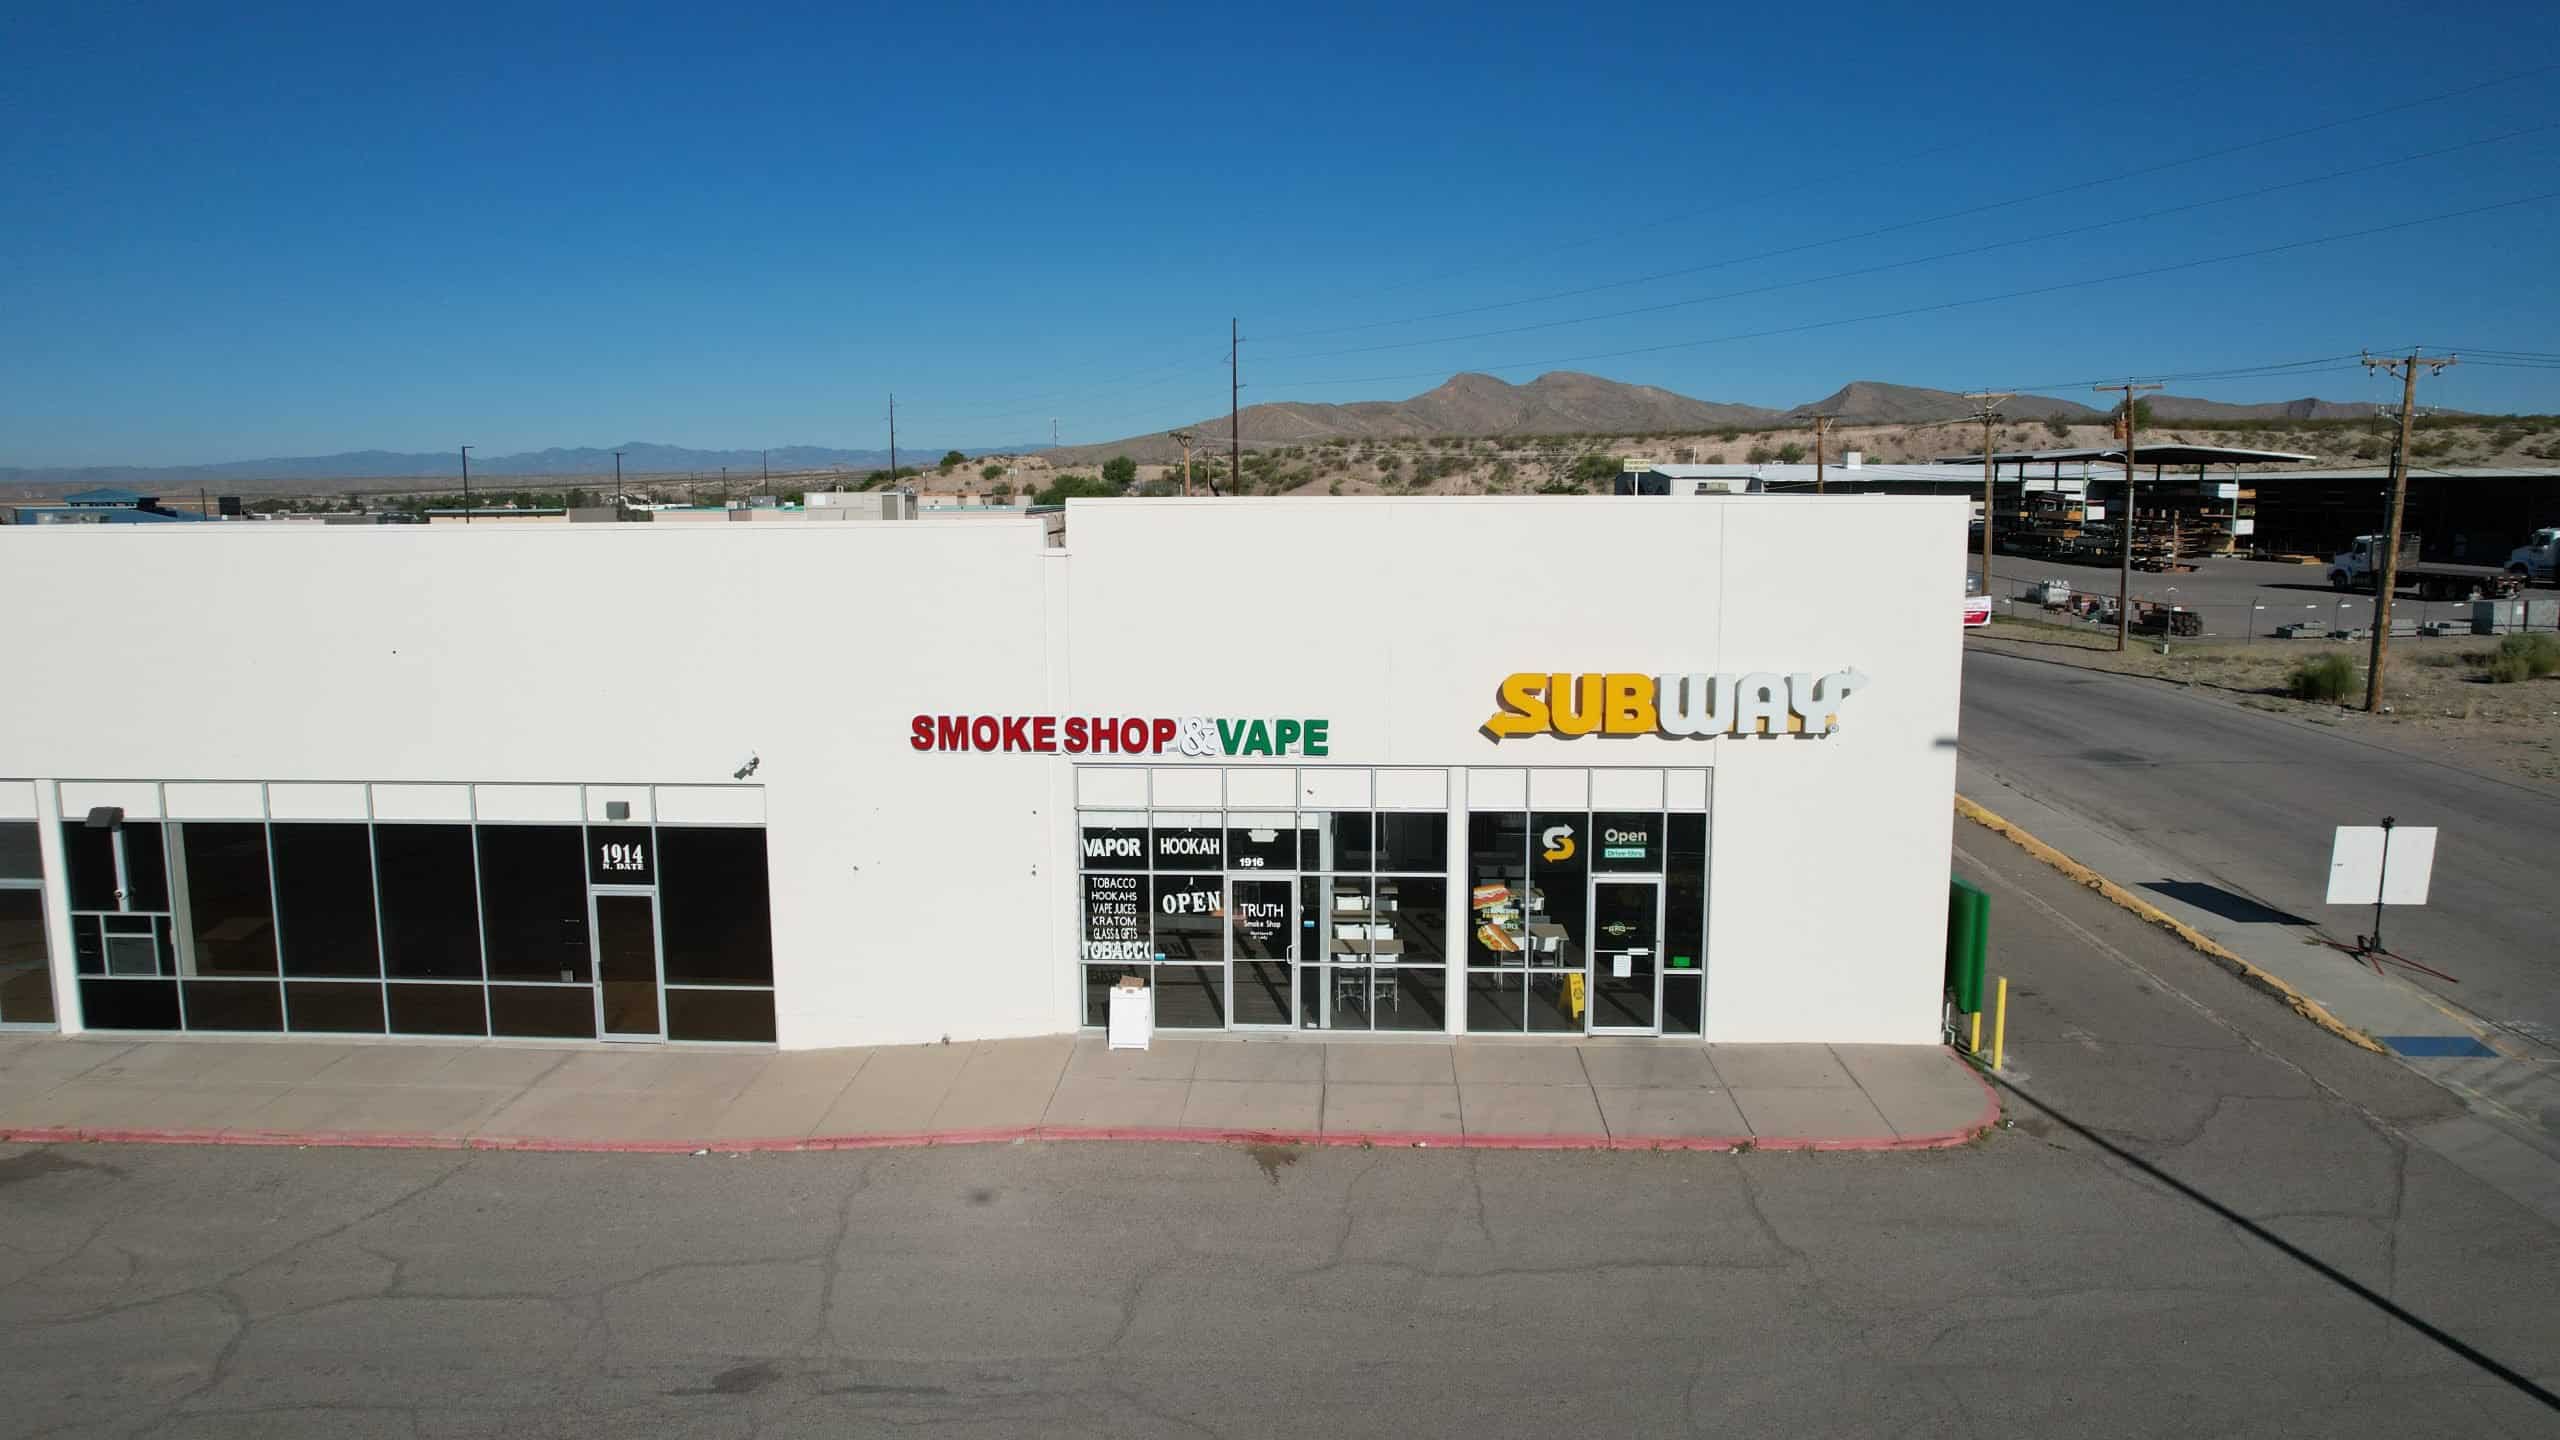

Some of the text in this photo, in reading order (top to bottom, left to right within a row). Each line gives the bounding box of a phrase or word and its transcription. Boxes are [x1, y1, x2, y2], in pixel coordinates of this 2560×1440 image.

[1479, 668, 1867, 744] SUBWAY
[910, 714, 1329, 757] SMOKE SHOP & VAPE
[1604, 828, 1648, 845] Open
[601, 843, 643, 863] 1914
[1083, 838, 1141, 857] VAPOR
[1160, 838, 1220, 855] HOOKAH
[1239, 857, 1264, 867] 1916
[1092, 877, 1137, 889] TOBACCO
[1091, 891, 1138, 901] HOOKAHS
[1162, 891, 1221, 914] OPEN
[1092, 903, 1113, 914] VAPE
[1240, 903, 1284, 918] TRUTH
[1092, 916, 1137, 926] KRATOM
[1093, 927, 1115, 940] GLASS
[1121, 927, 1138, 940] GIFTS
